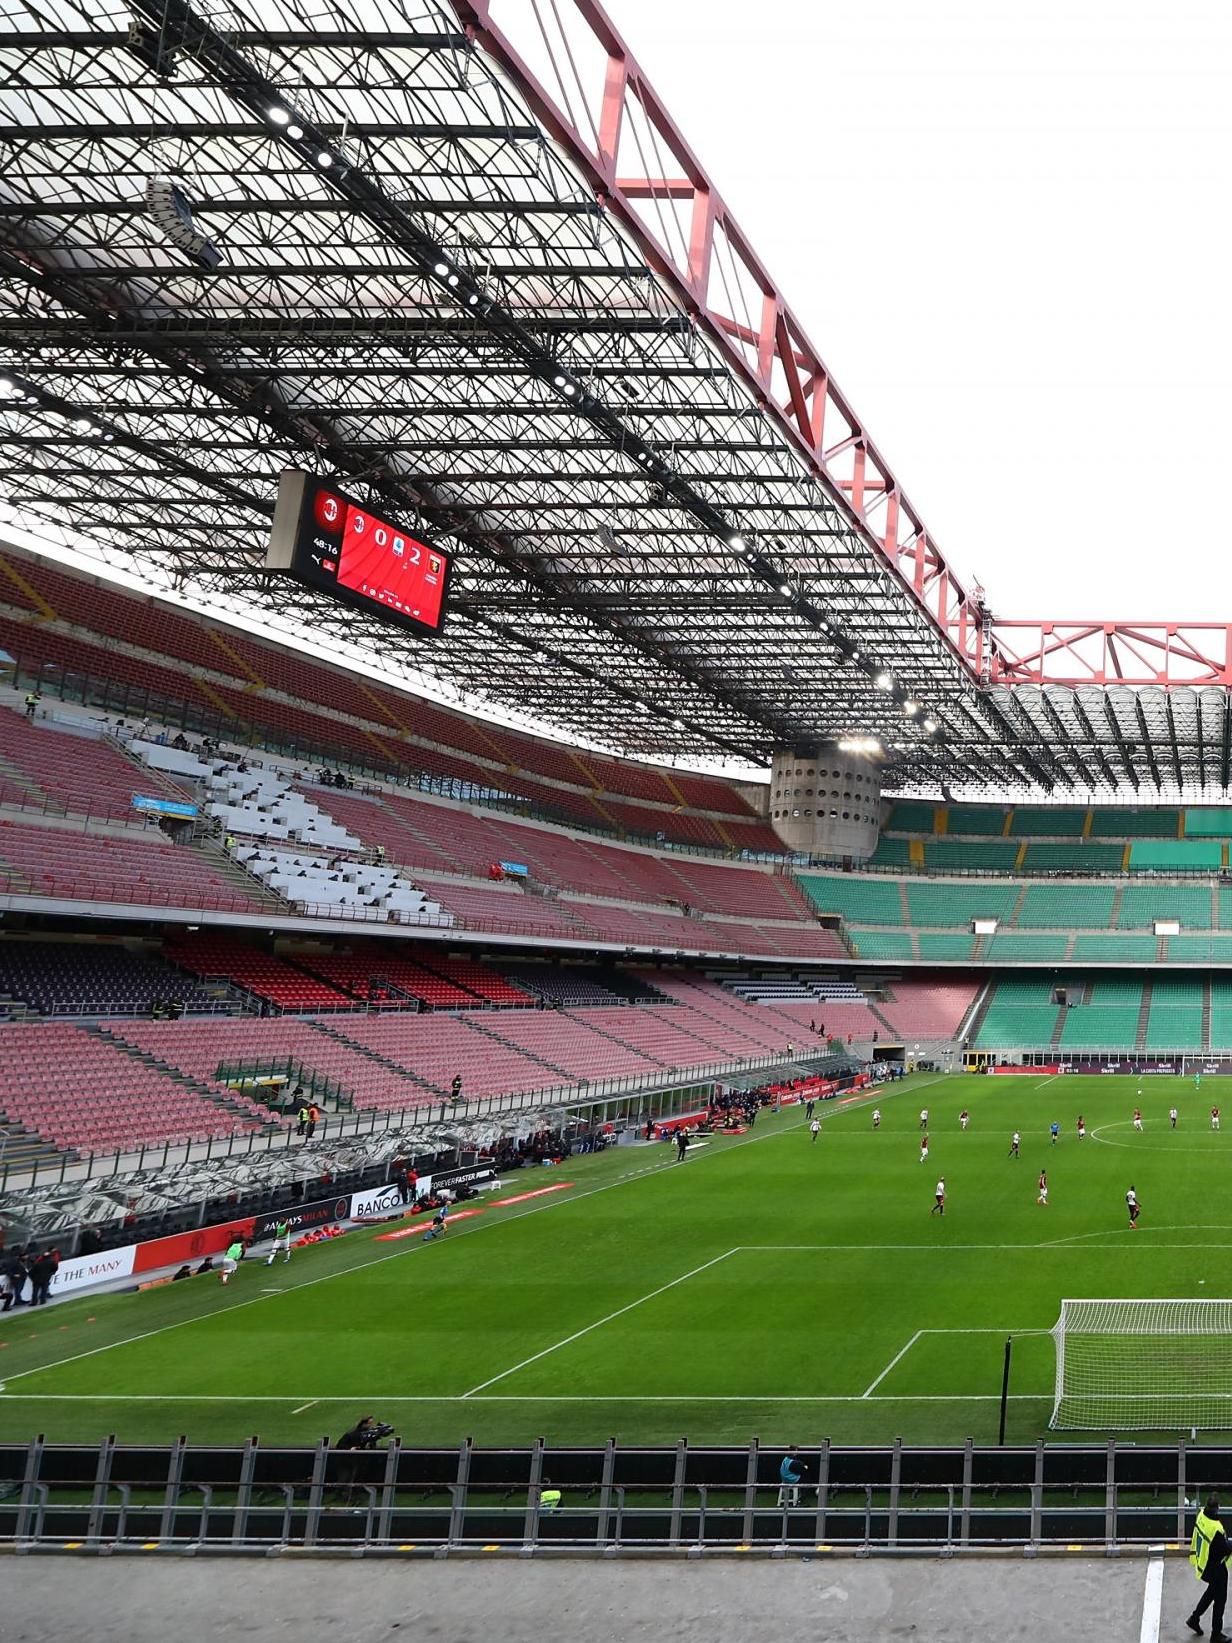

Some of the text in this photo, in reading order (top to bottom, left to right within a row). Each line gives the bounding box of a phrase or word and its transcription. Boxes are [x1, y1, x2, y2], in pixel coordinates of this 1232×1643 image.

[314, 538, 338, 554] 48:16
[375, 529, 421, 565] 0 2
[357, 1195, 400, 1216] BANCO
[64, 1268, 84, 1282] THE
[88, 1260, 122, 1276] MANY
